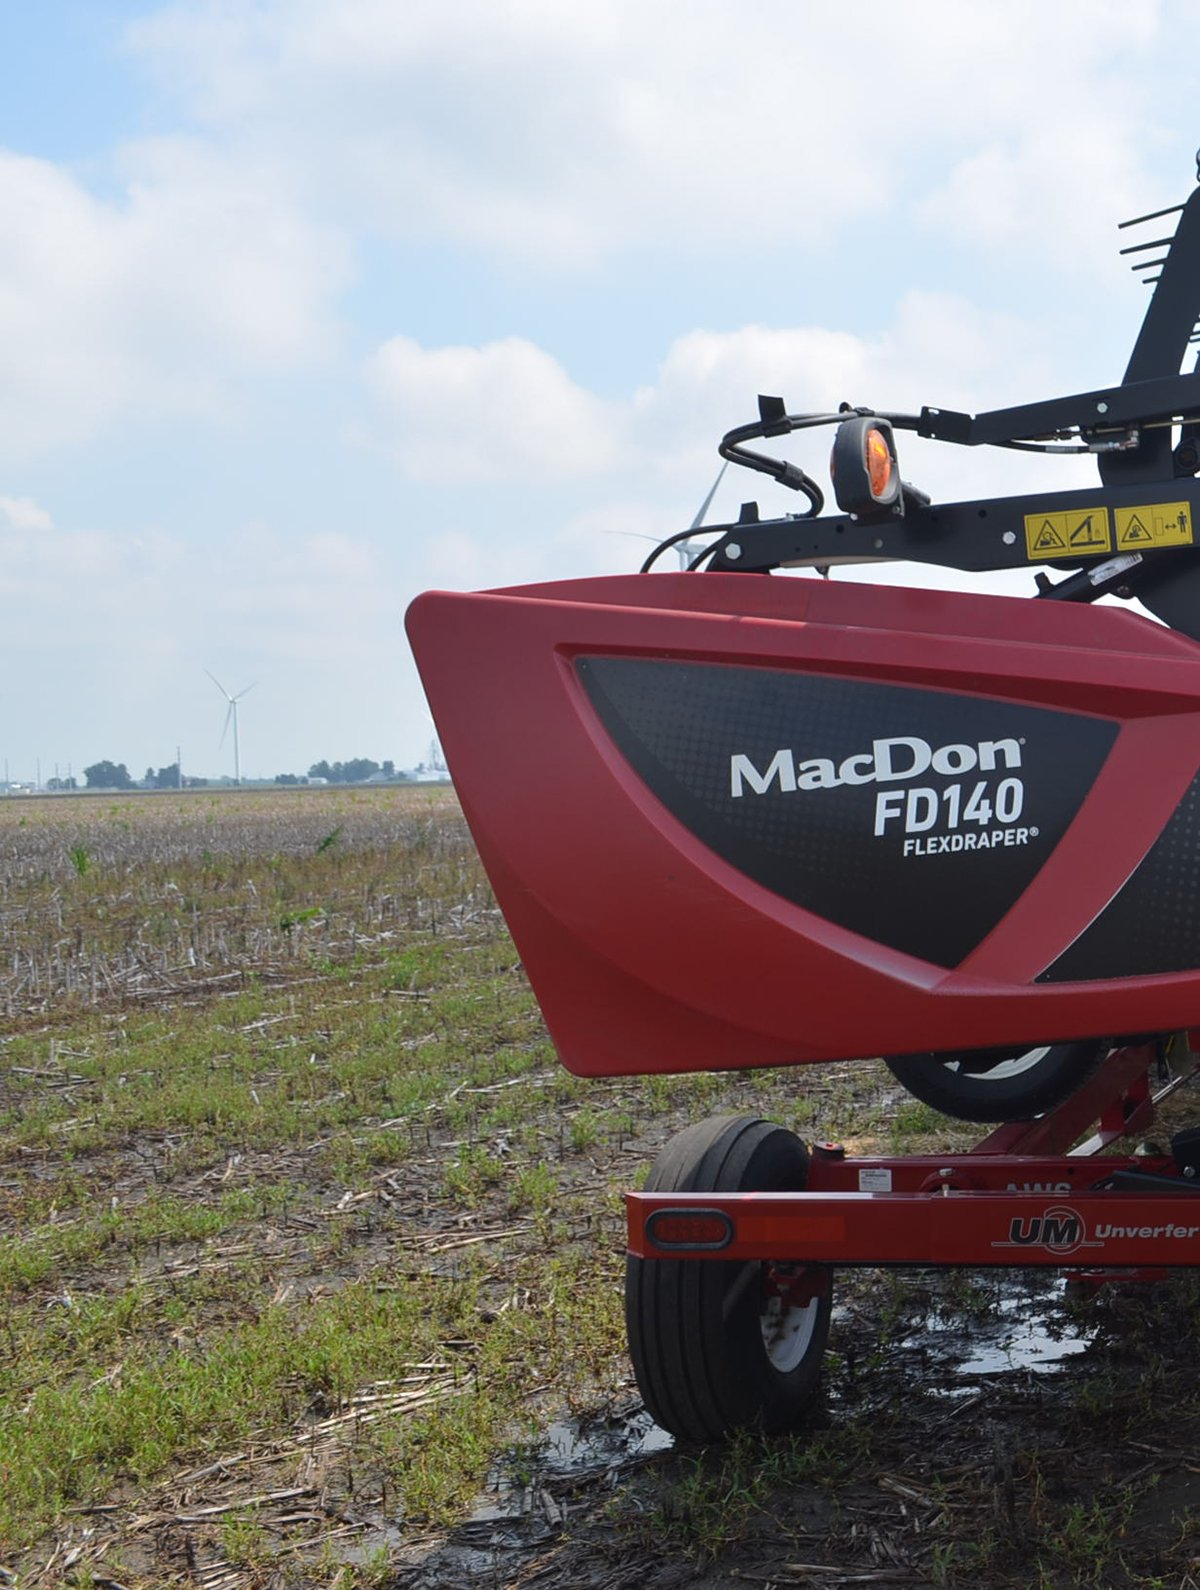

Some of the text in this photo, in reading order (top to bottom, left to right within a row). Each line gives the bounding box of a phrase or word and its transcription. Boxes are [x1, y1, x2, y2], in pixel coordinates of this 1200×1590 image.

[731, 736, 1022, 798] MacDon
[874, 778, 1024, 836] FD140
[1009, 1217, 1081, 1244] UM
